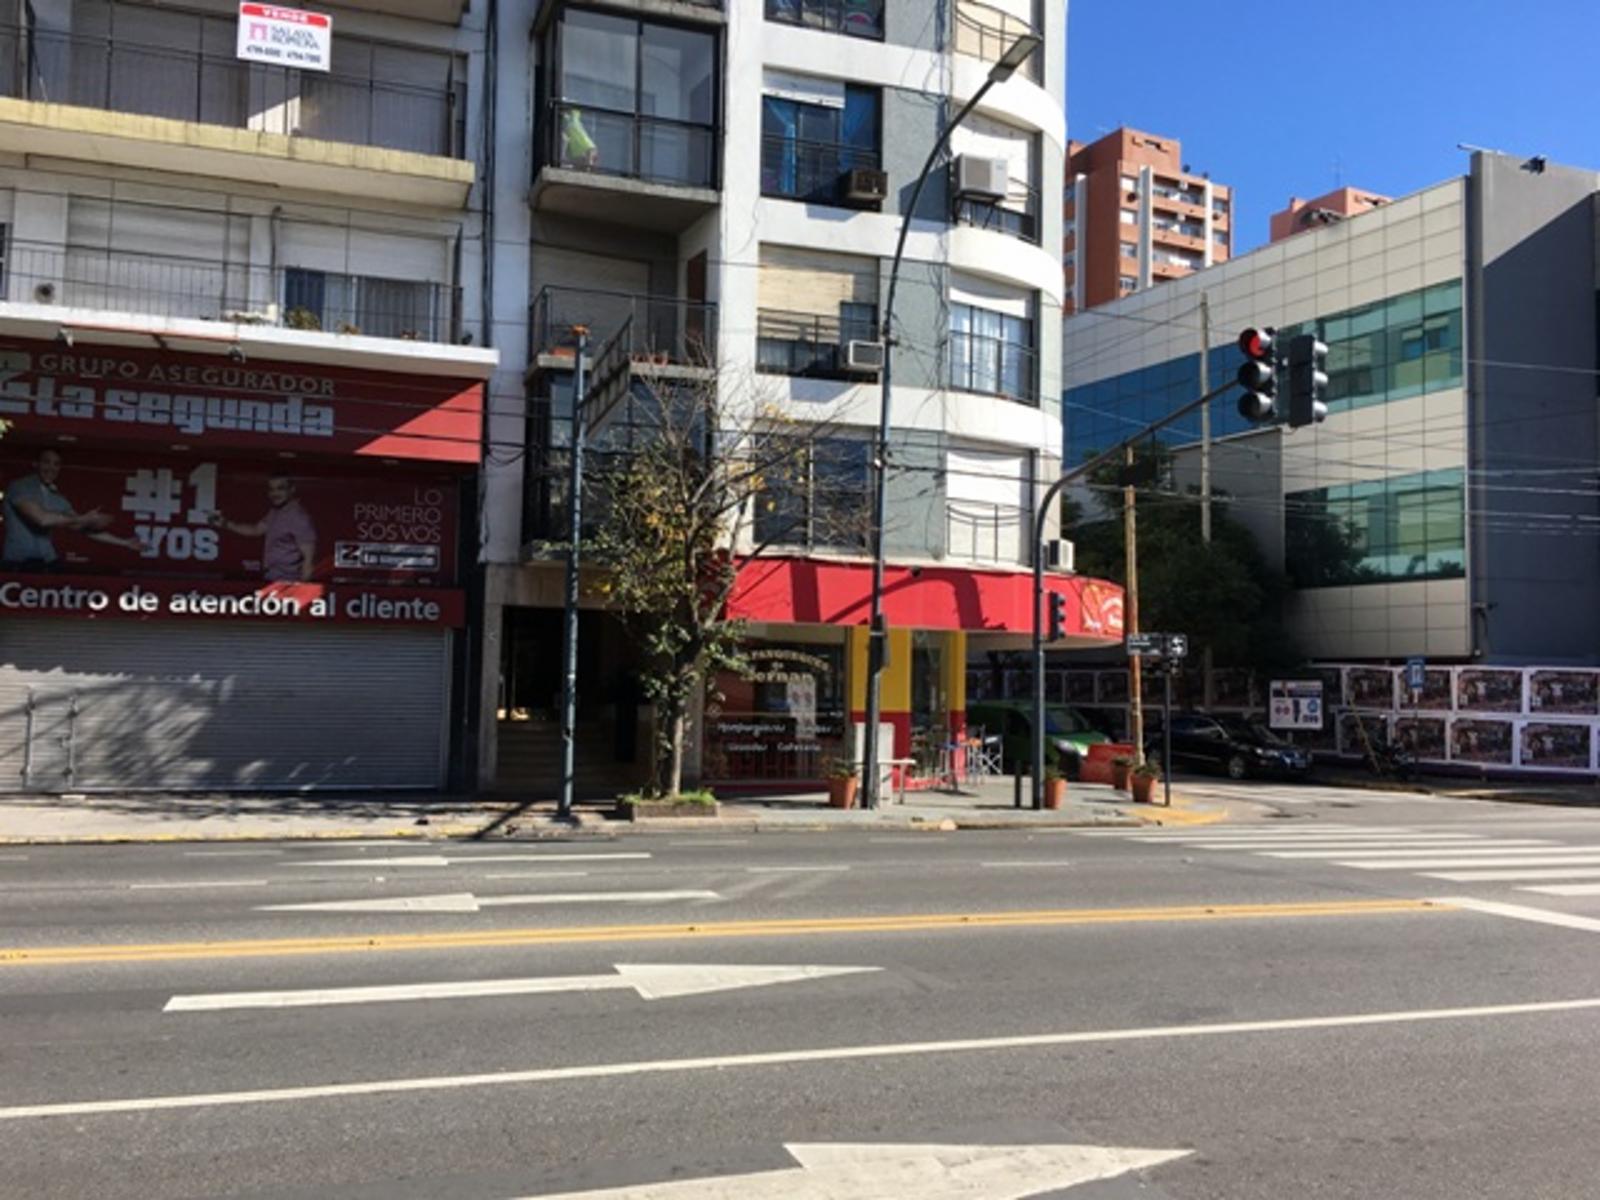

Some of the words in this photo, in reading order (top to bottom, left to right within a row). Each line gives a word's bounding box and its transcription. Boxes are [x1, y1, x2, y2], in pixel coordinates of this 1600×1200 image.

[39, 354, 139, 378] GRUPO
[148, 363, 335, 394] ASEGURADOR
[35, 377, 95, 418] la
[104, 389, 334, 436] segunda
[121, 462, 222, 523] #1
[414, 488, 442, 505] LO
[354, 503, 442, 524] PRIMERO
[357, 522, 399, 541] SOS
[400, 524, 442, 543] VOS
[0, 582, 109, 610] Centro
[119, 584, 159, 611] de
[169, 589, 299, 616] atención
[309, 592, 336, 616] al
[346, 594, 440, 620] cliente
